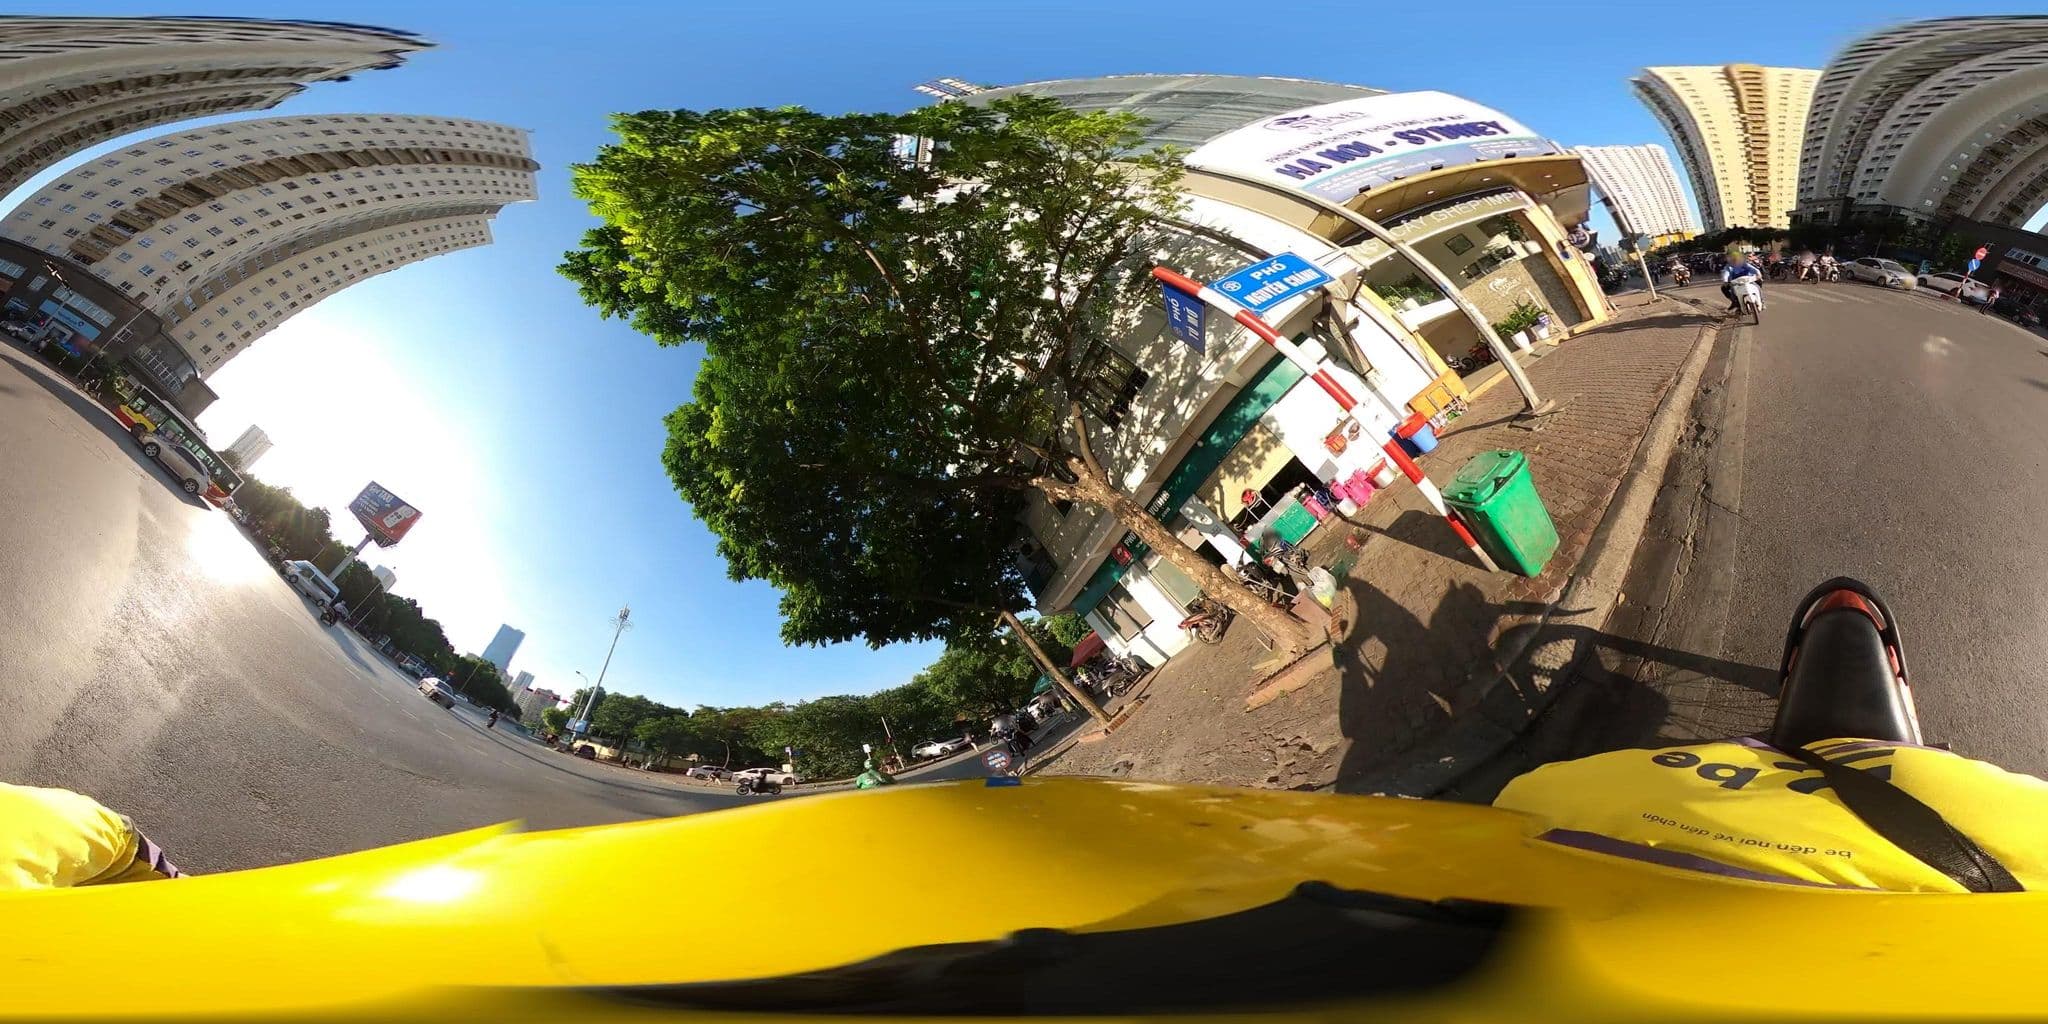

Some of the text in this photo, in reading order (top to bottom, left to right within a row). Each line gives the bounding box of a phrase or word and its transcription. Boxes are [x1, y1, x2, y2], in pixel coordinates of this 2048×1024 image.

[1393, 120, 1510, 145] SYDNEY
[1249, 259, 1288, 280] PHỐ
[1243, 268, 1322, 307] NGUYỄN CHÁNH
[1166, 296, 1182, 322] PHỐ
[1652, 751, 1761, 791] be
[1824, 848, 1852, 859] be
